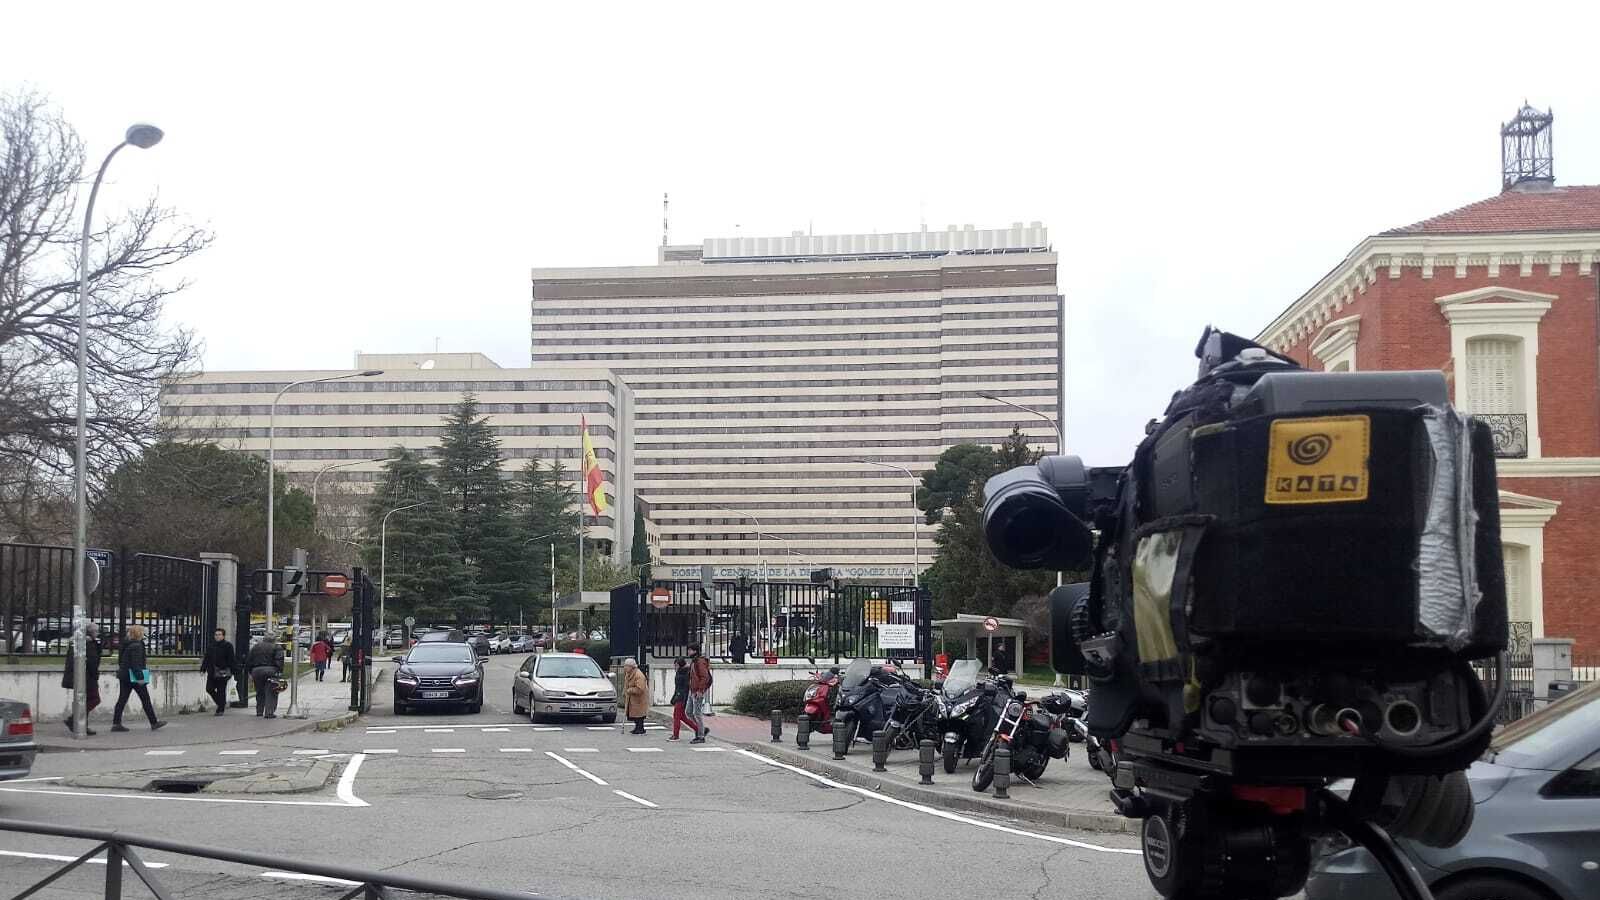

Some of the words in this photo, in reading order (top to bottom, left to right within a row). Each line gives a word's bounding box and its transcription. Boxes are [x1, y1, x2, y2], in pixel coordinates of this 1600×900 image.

[1276, 475, 1358, 492] KATA
[768, 568, 783, 577] DE
[784, 568, 797, 577] LA
